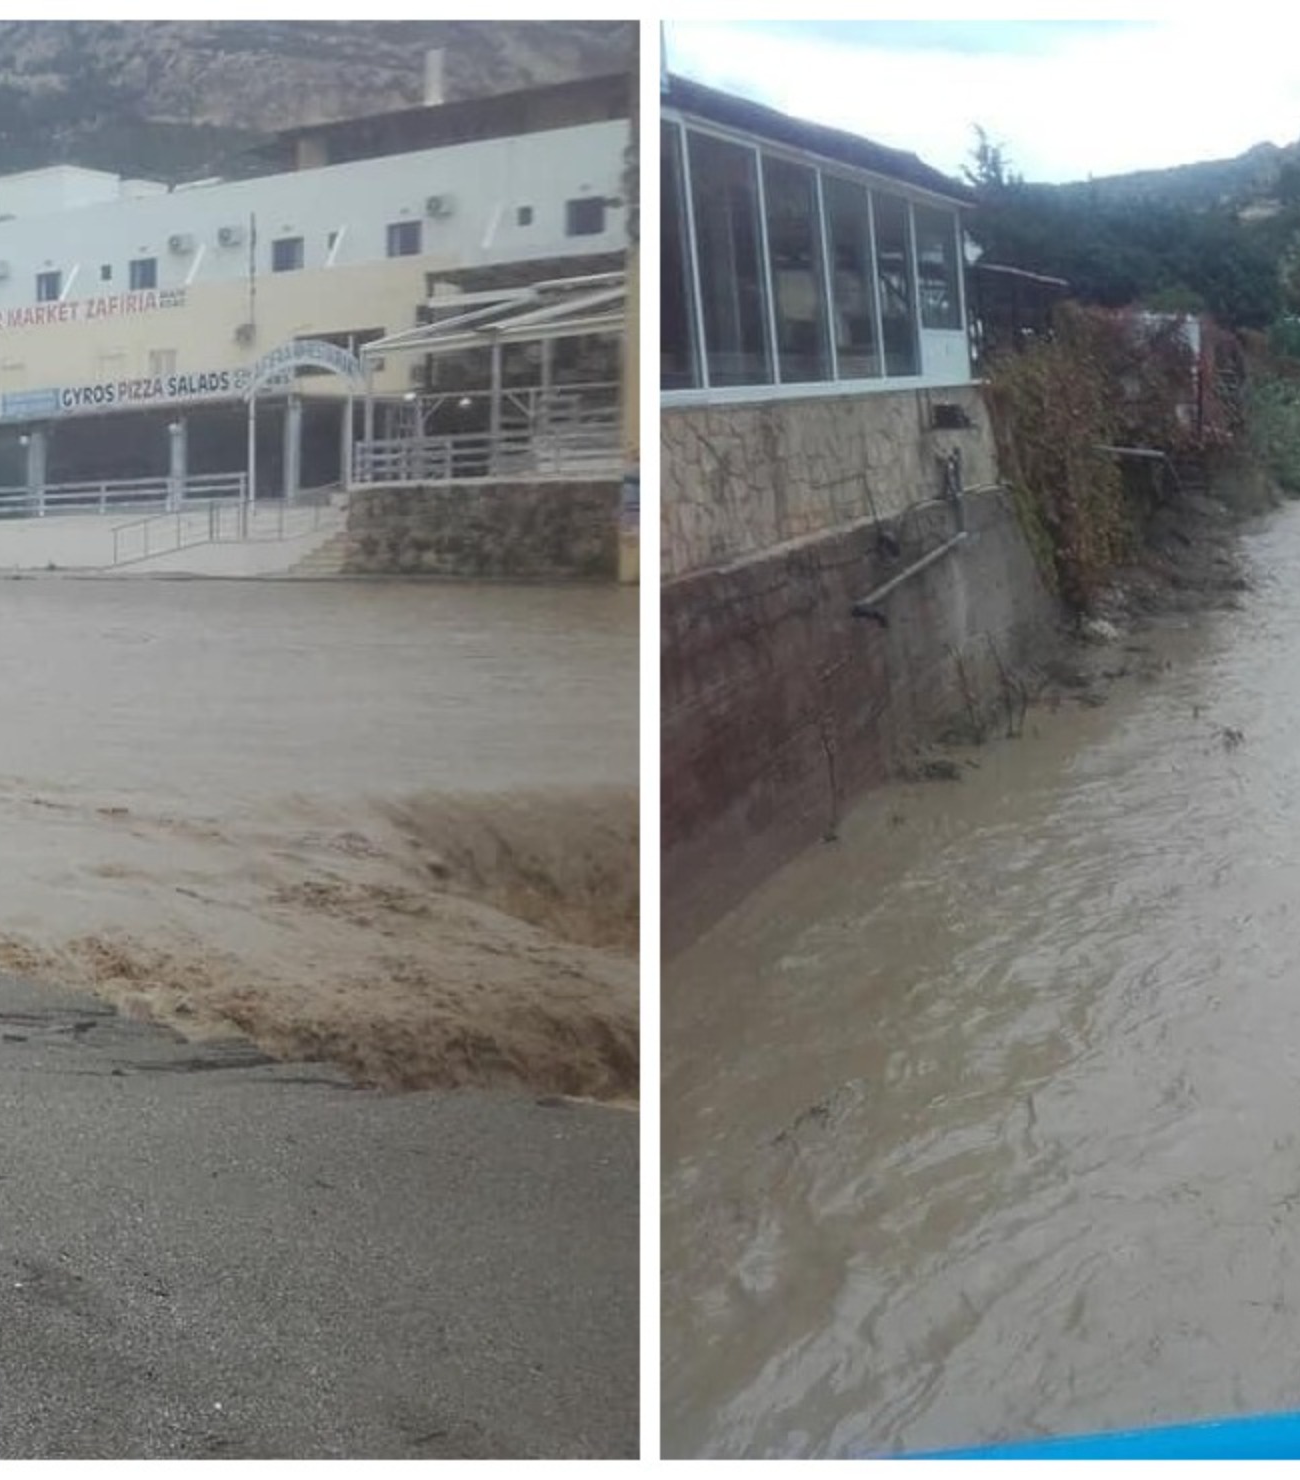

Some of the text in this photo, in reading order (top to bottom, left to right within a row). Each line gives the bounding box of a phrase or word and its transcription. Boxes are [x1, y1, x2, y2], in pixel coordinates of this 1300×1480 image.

[7, 301, 79, 328] MARKET
[86, 291, 158, 320] ZAFIRIA
[62, 384, 115, 407] GYROS
[118, 377, 163, 400] PIZZA
[168, 371, 230, 397] SALADS
